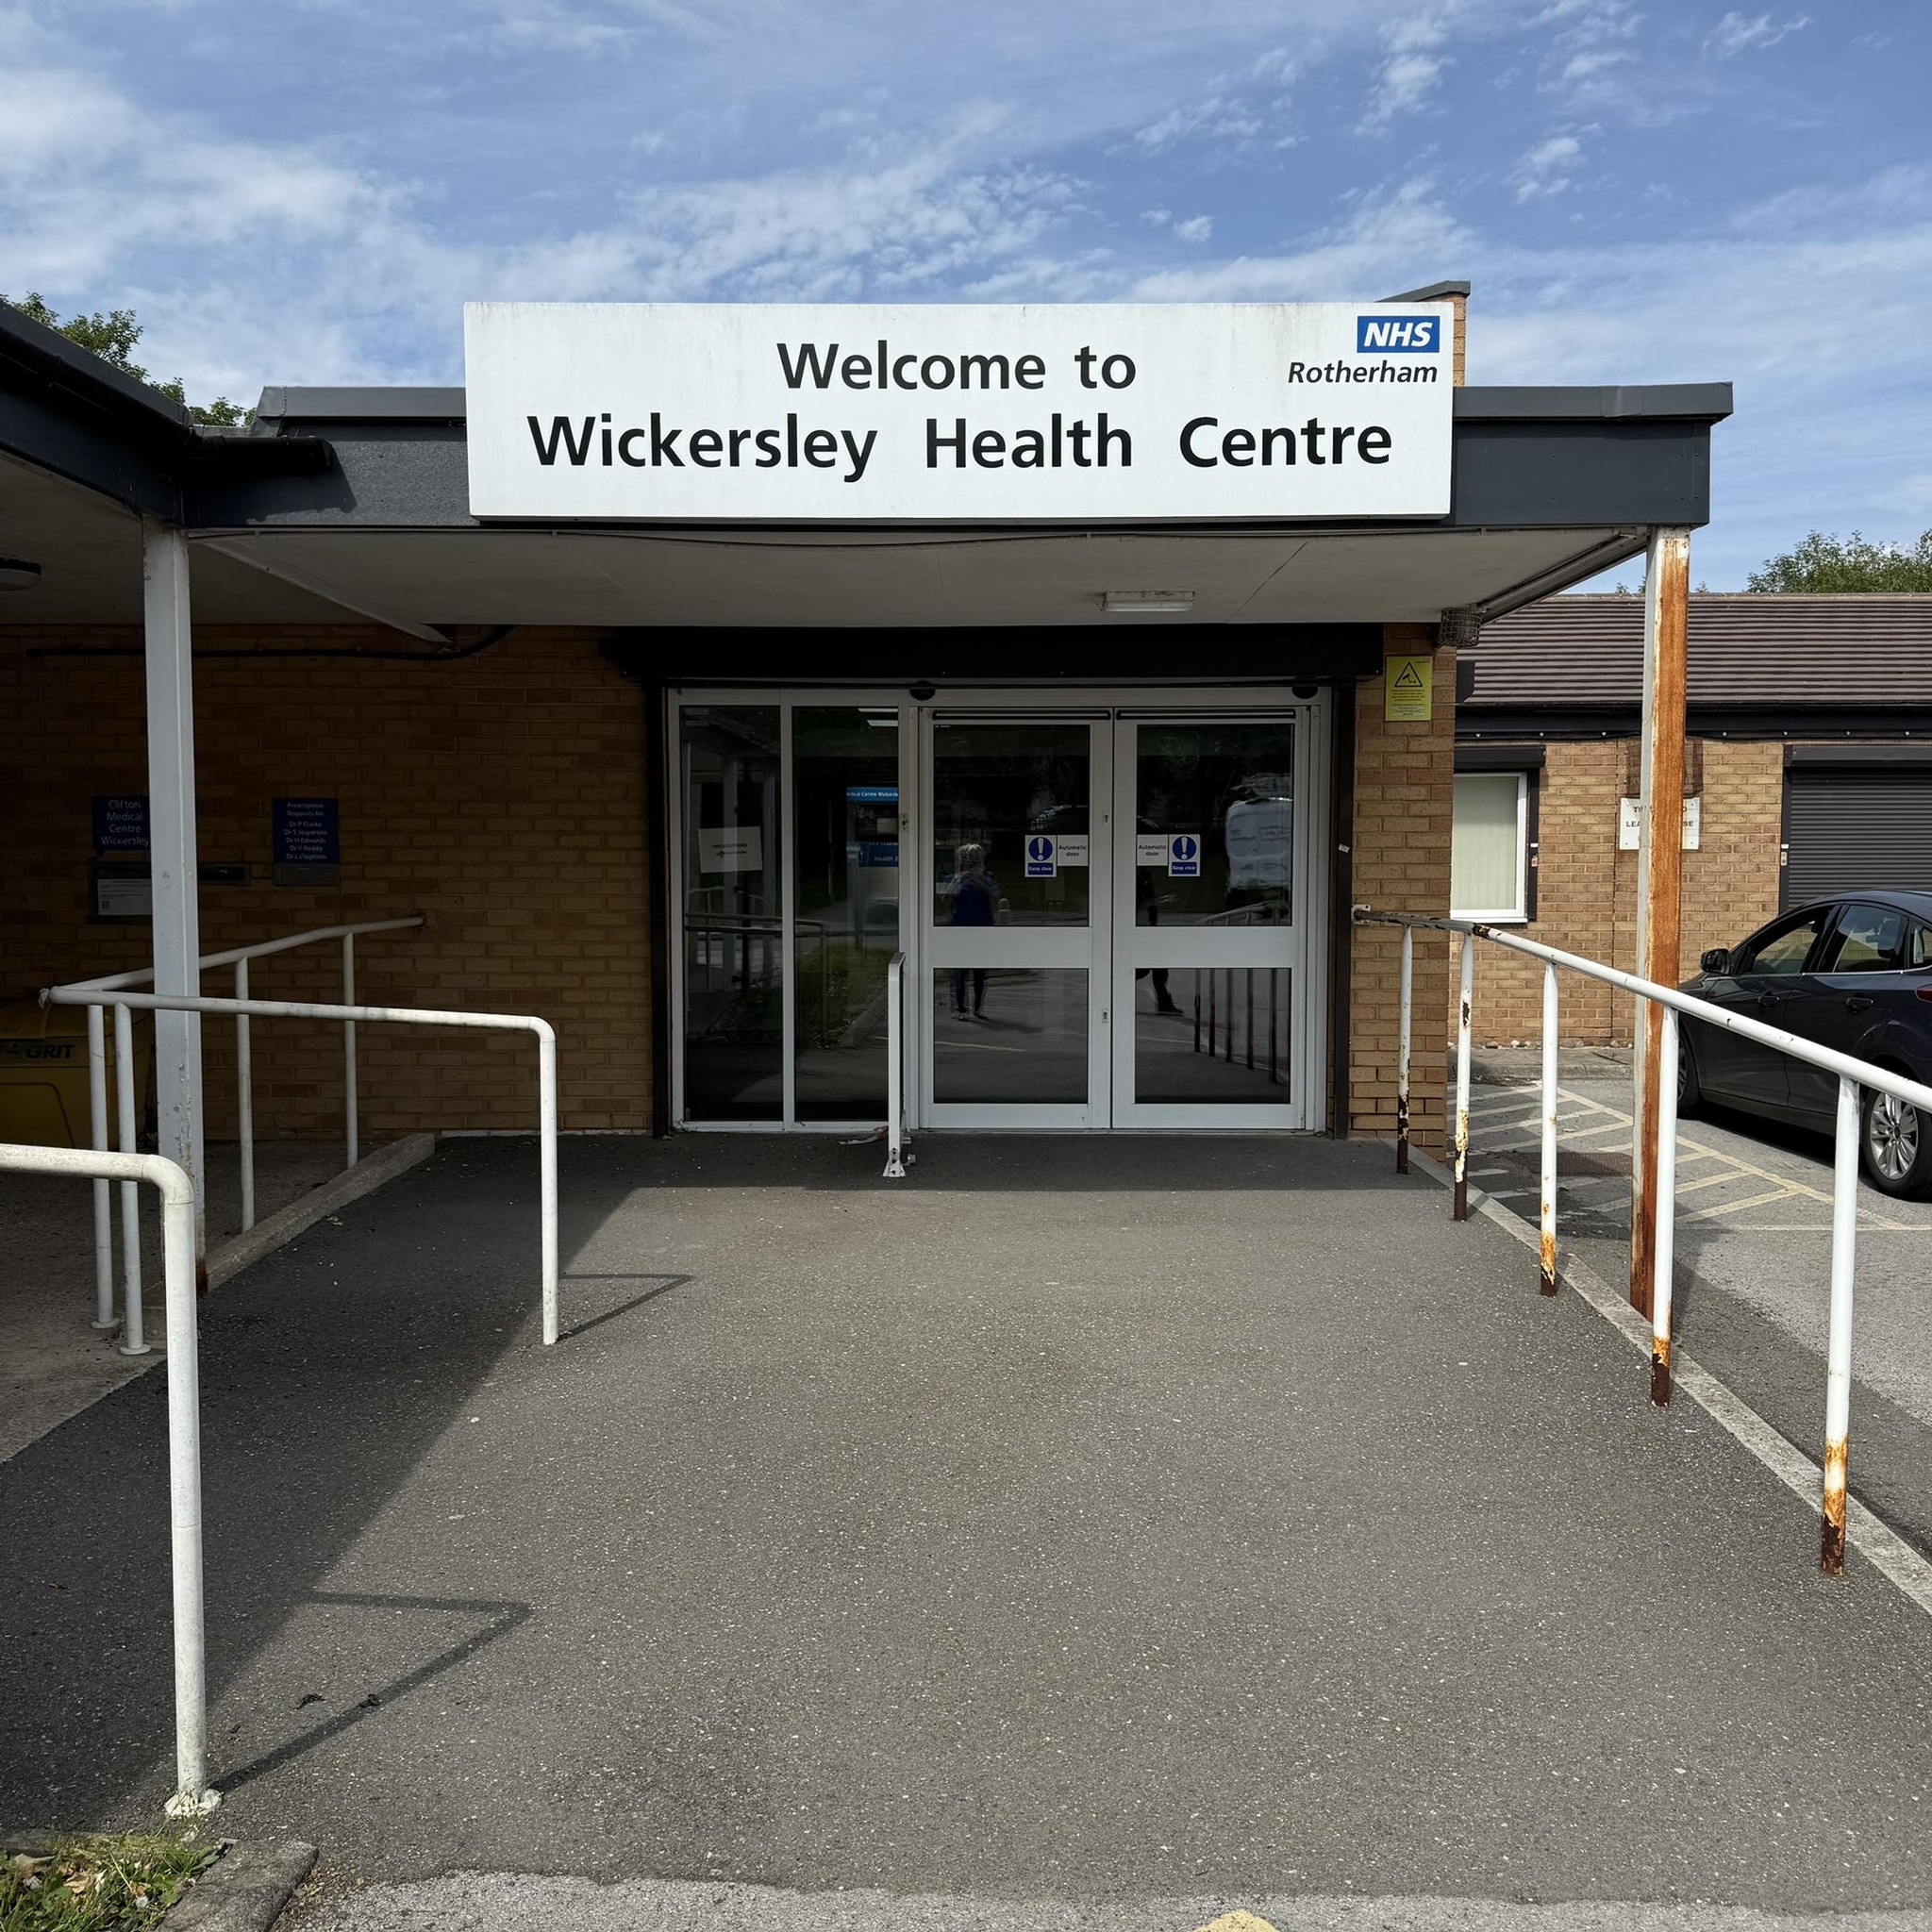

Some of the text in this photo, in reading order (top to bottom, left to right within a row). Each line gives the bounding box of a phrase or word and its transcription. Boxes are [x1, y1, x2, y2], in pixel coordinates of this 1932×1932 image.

[1363, 322, 1433, 347] NHS
[777, 341, 1136, 391] Welcome to
[1289, 359, 1438, 384] Rotherham
[527, 412, 1392, 483] Wickersley Health Centre
[108, 799, 141, 809] Clifton
[107, 811, 143, 821] Medical
[108, 824, 142, 834] Centre
[26, 1043, 75, 1058] GRIT
